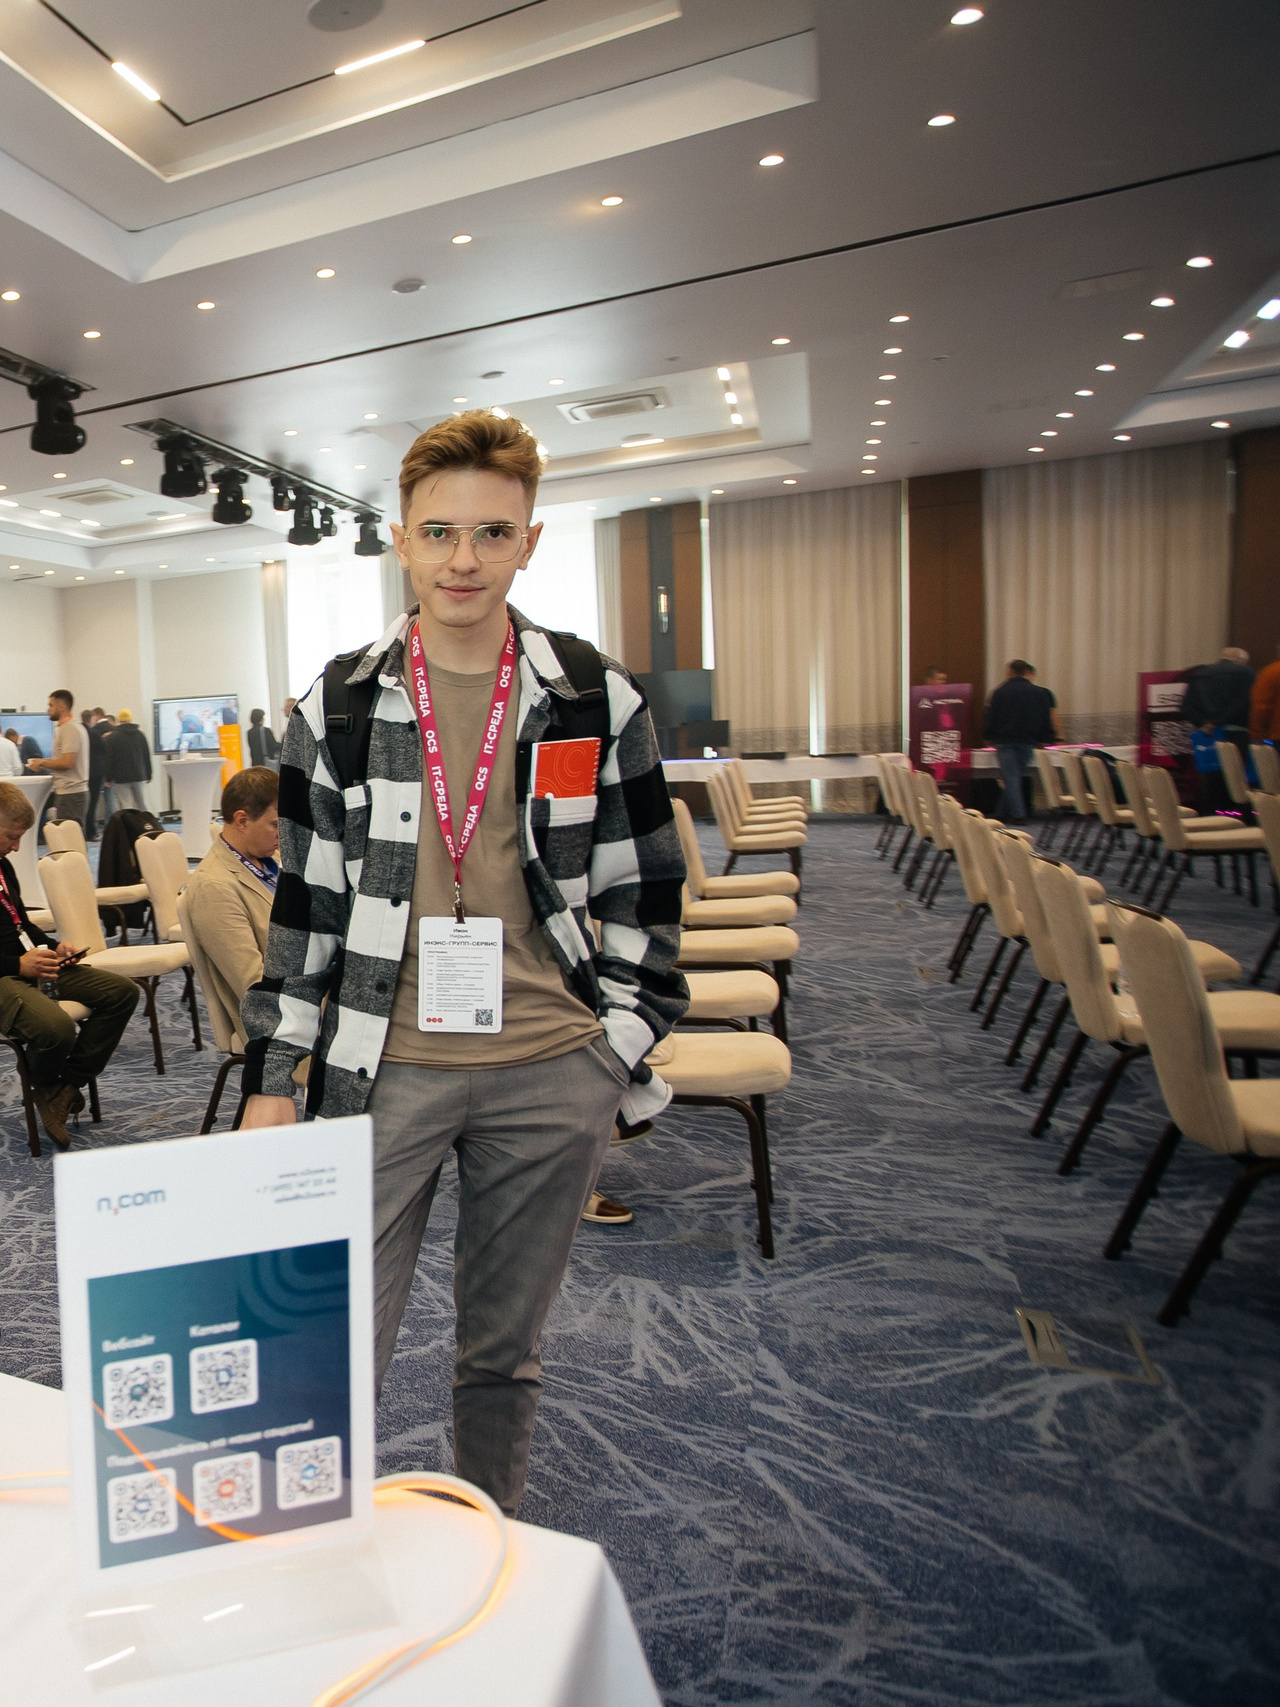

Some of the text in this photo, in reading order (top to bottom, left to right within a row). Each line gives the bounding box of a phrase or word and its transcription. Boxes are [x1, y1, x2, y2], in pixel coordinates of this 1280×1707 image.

[412, 635, 420, 657] OCS
[500, 664, 512, 688] OCS
[415, 666, 432, 718] IT-СРЕДА
[483, 700, 505, 754] IT-СРЕДА
[425, 729, 439, 754] OCS
[474, 766, 489, 791] OCS
[431, 765, 449, 821] IT-СРЕДА
[445, 834, 457, 859] OCS
